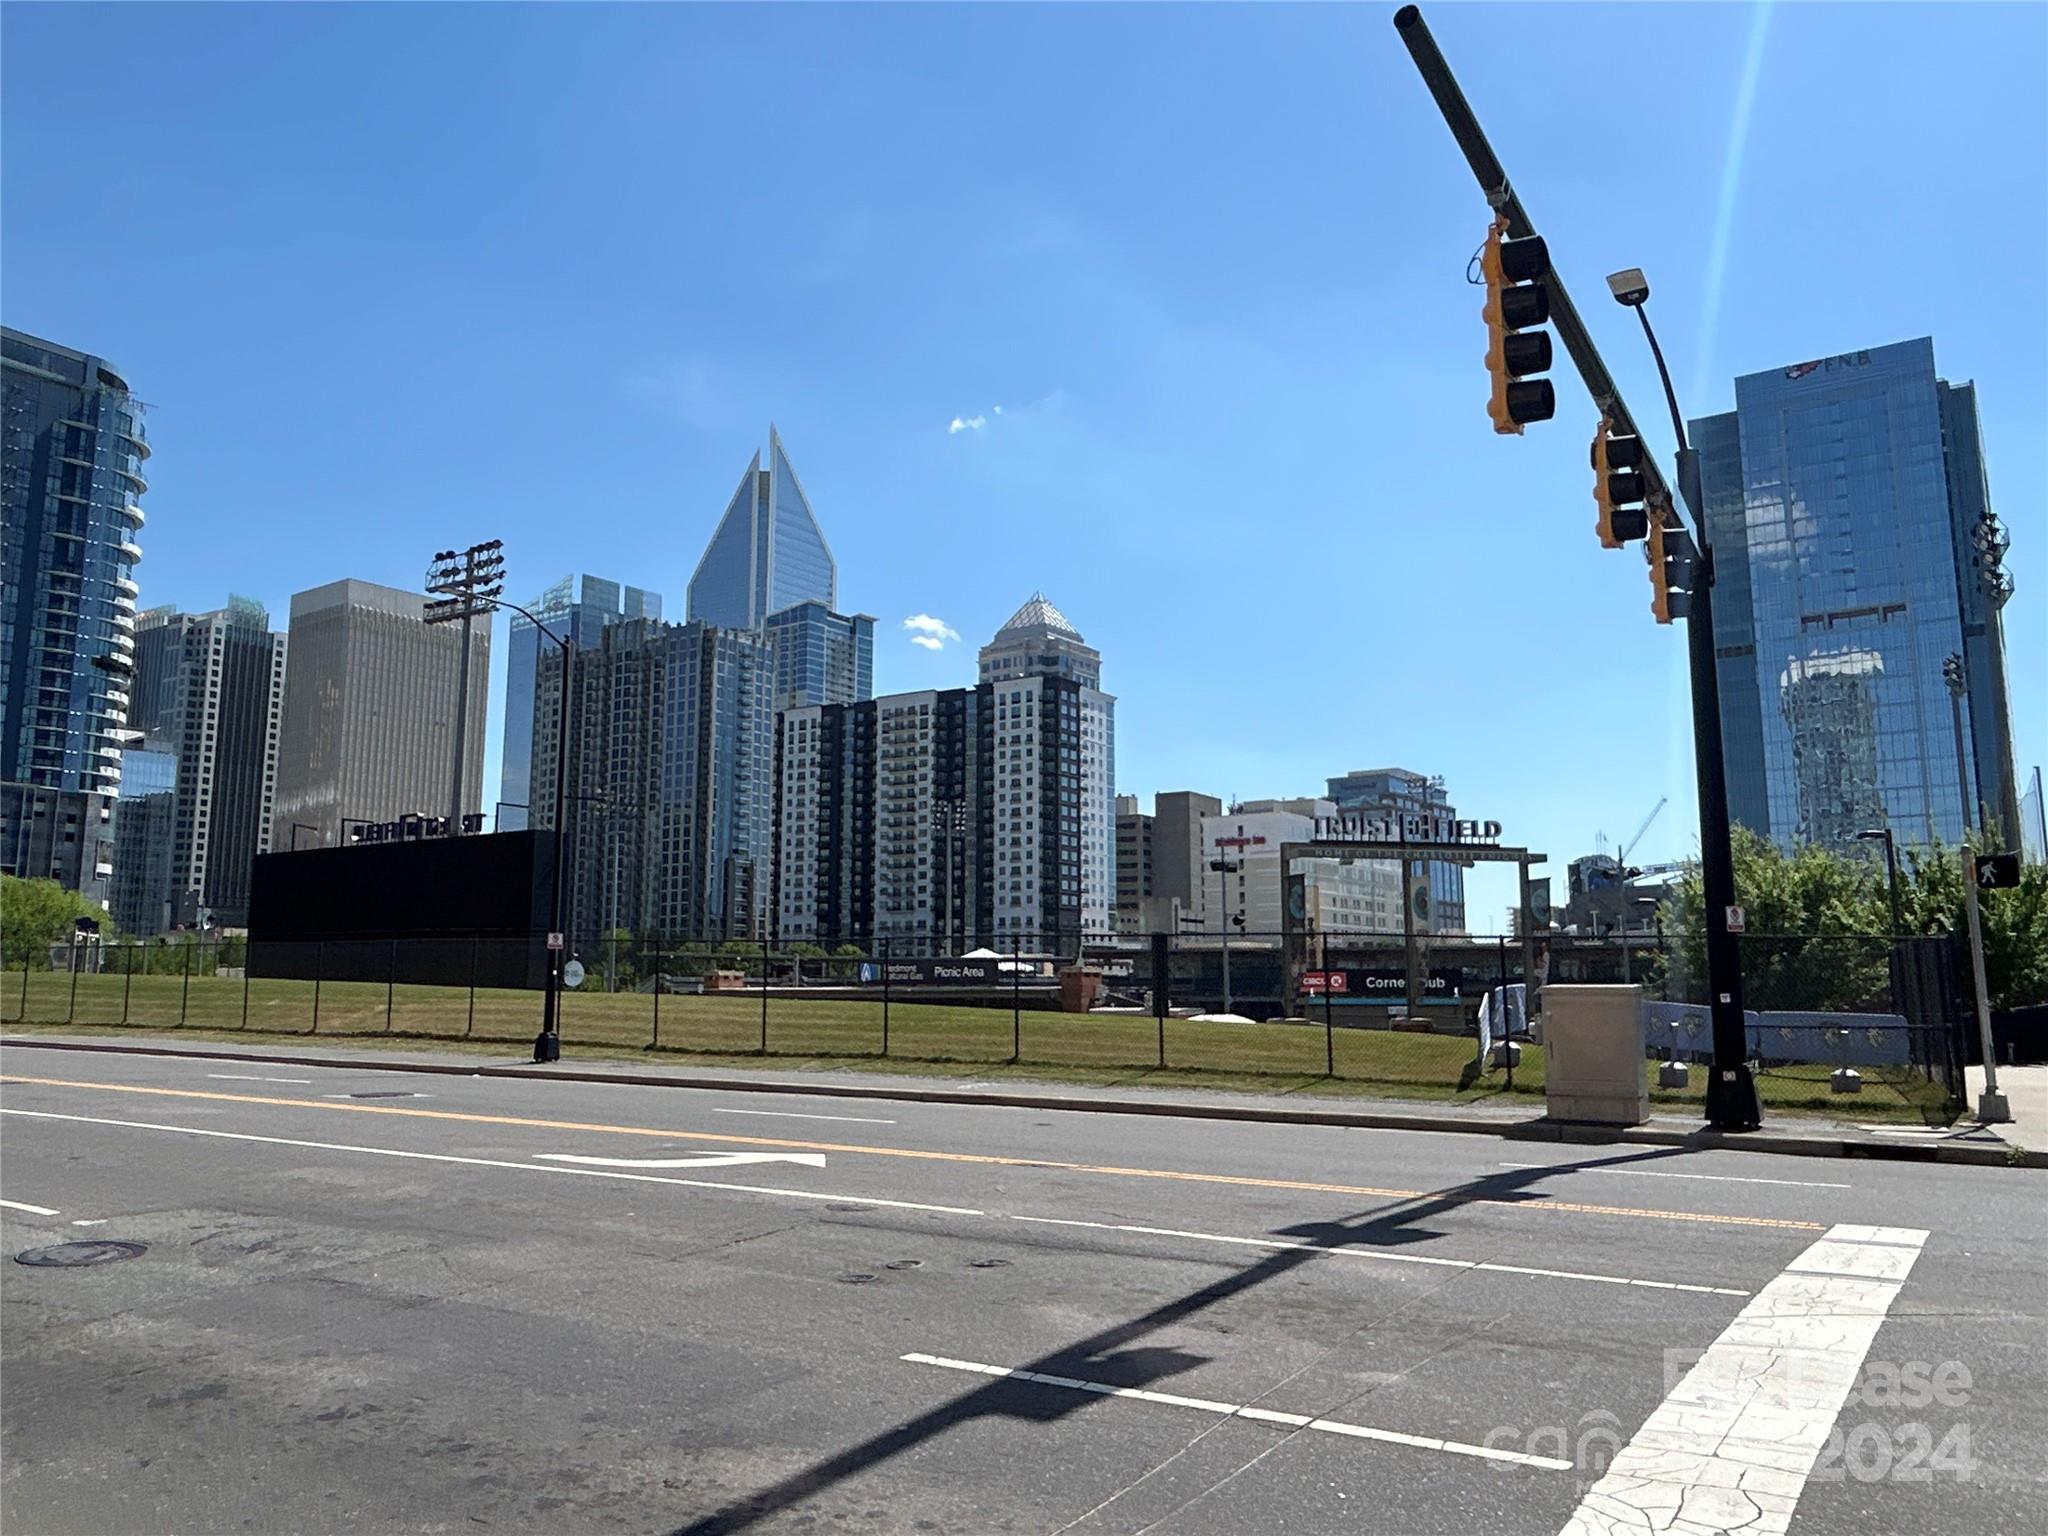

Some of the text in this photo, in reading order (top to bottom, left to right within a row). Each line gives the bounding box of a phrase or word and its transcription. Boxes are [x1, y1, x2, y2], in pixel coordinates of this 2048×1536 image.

[1312, 816, 1503, 839] TRUIST FIELD
[934, 966, 984, 977] Picnic Area
[1366, 976, 1406, 989] Corne
